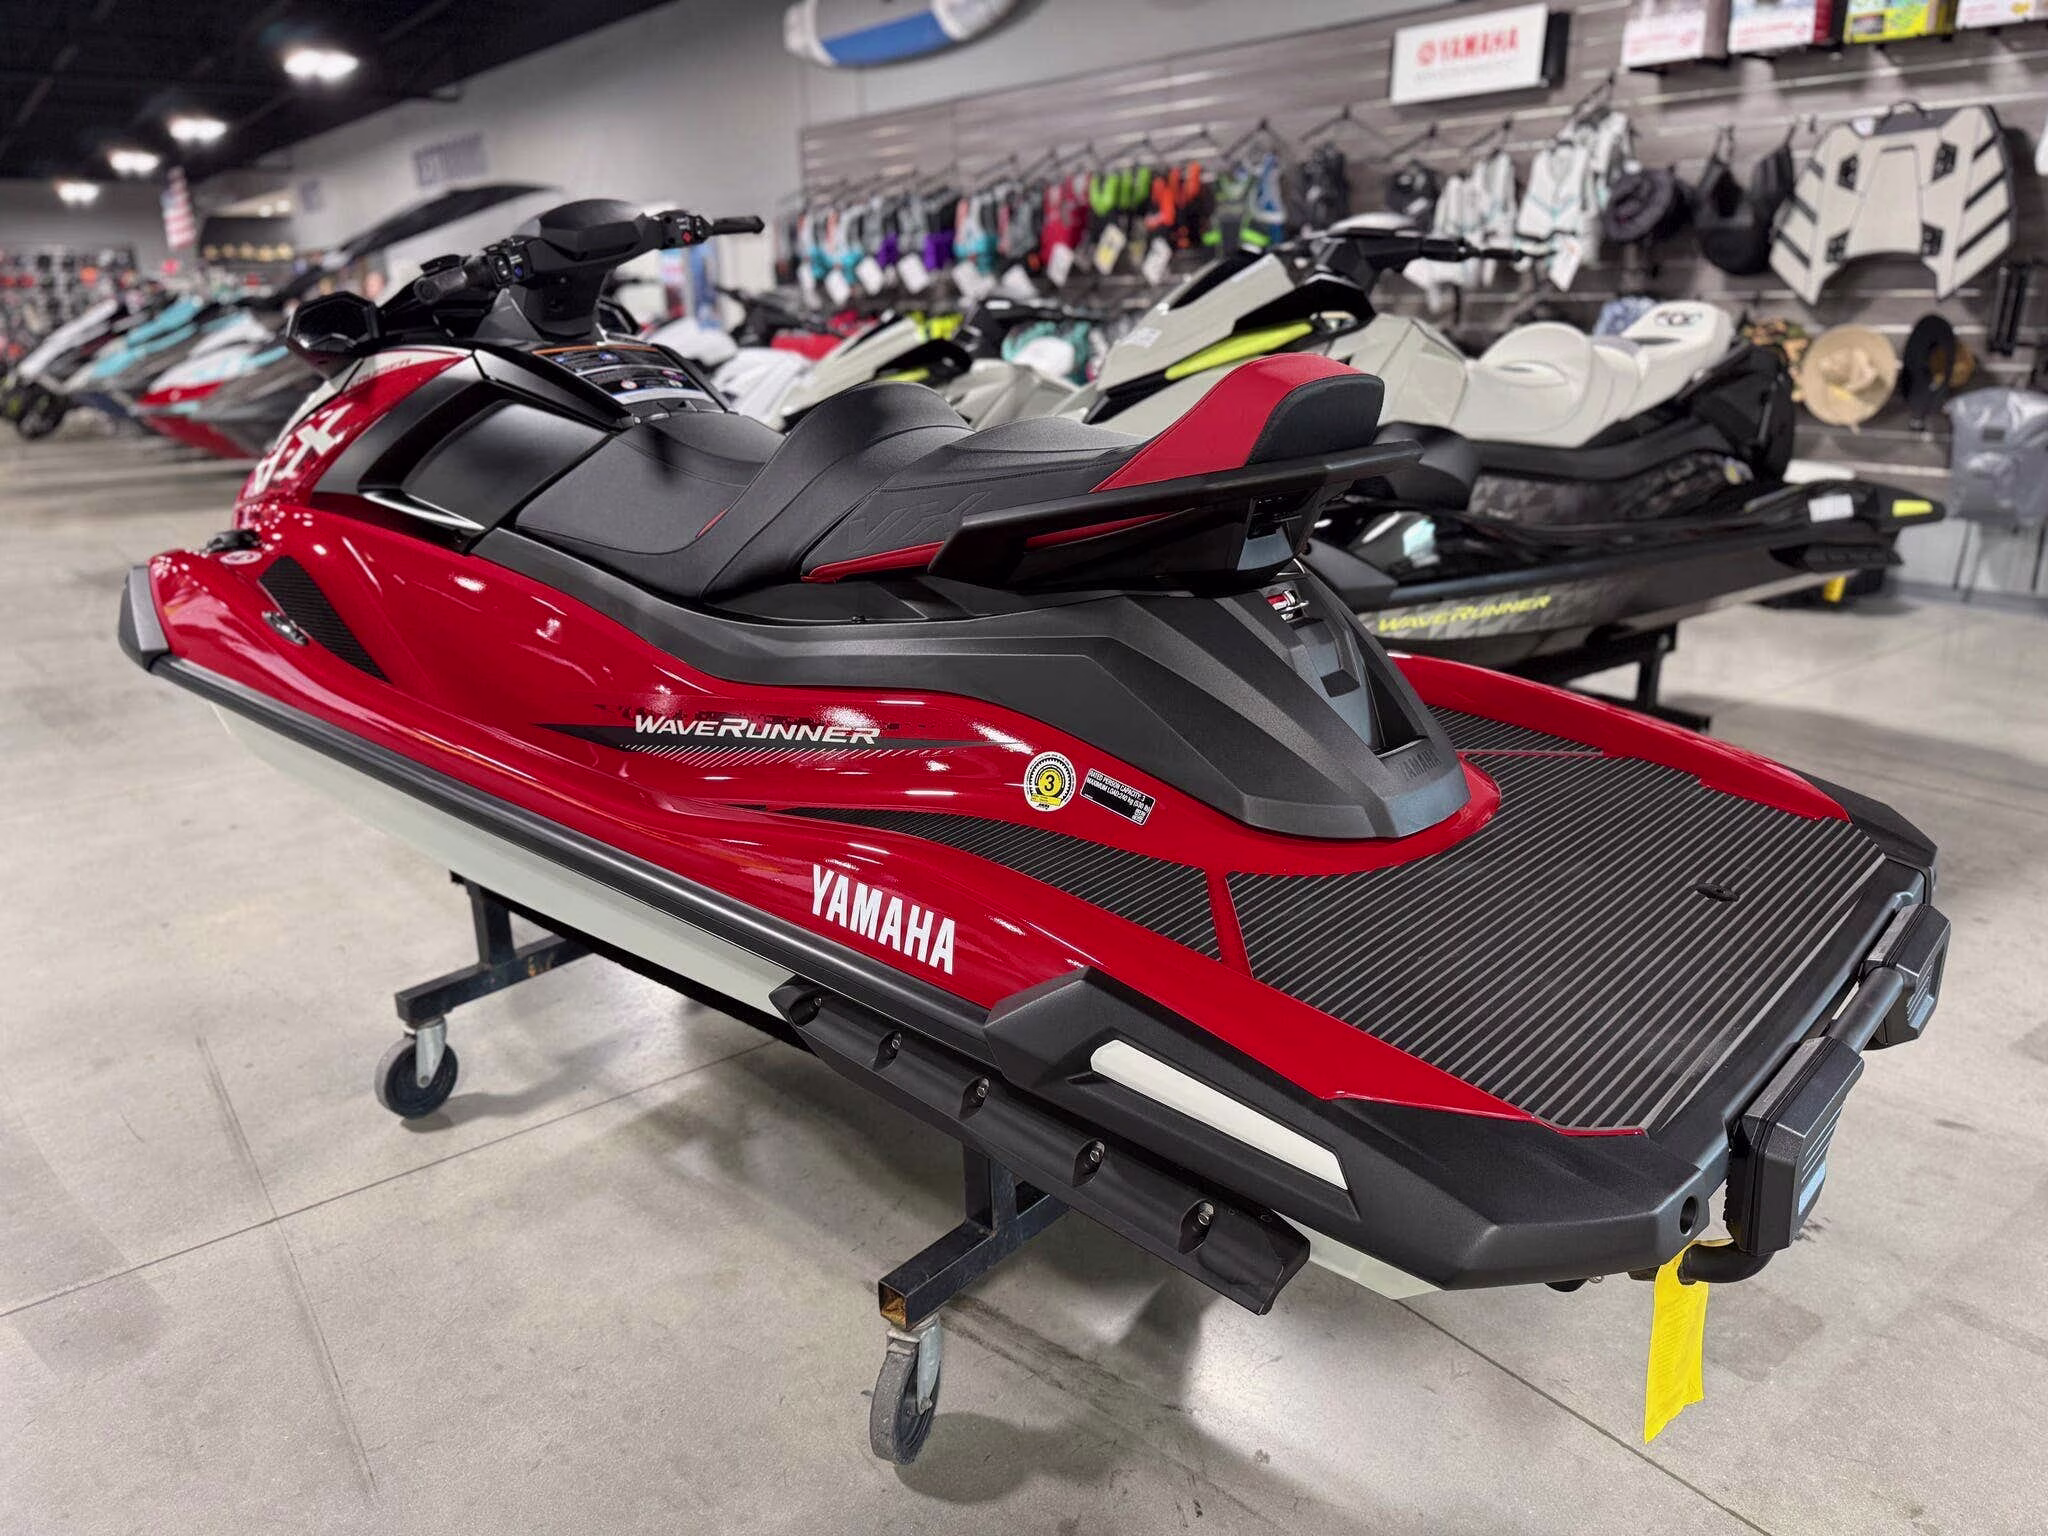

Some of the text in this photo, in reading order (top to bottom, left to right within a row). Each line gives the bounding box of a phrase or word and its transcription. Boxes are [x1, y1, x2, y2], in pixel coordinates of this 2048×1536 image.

[1438, 27, 1519, 61] YAMAHA
[634, 715, 881, 744] WAVERUNNER
[1044, 774, 1055, 791] 3
[1101, 776, 1120, 790] PERSON
[812, 864, 955, 975] YAMAHA
